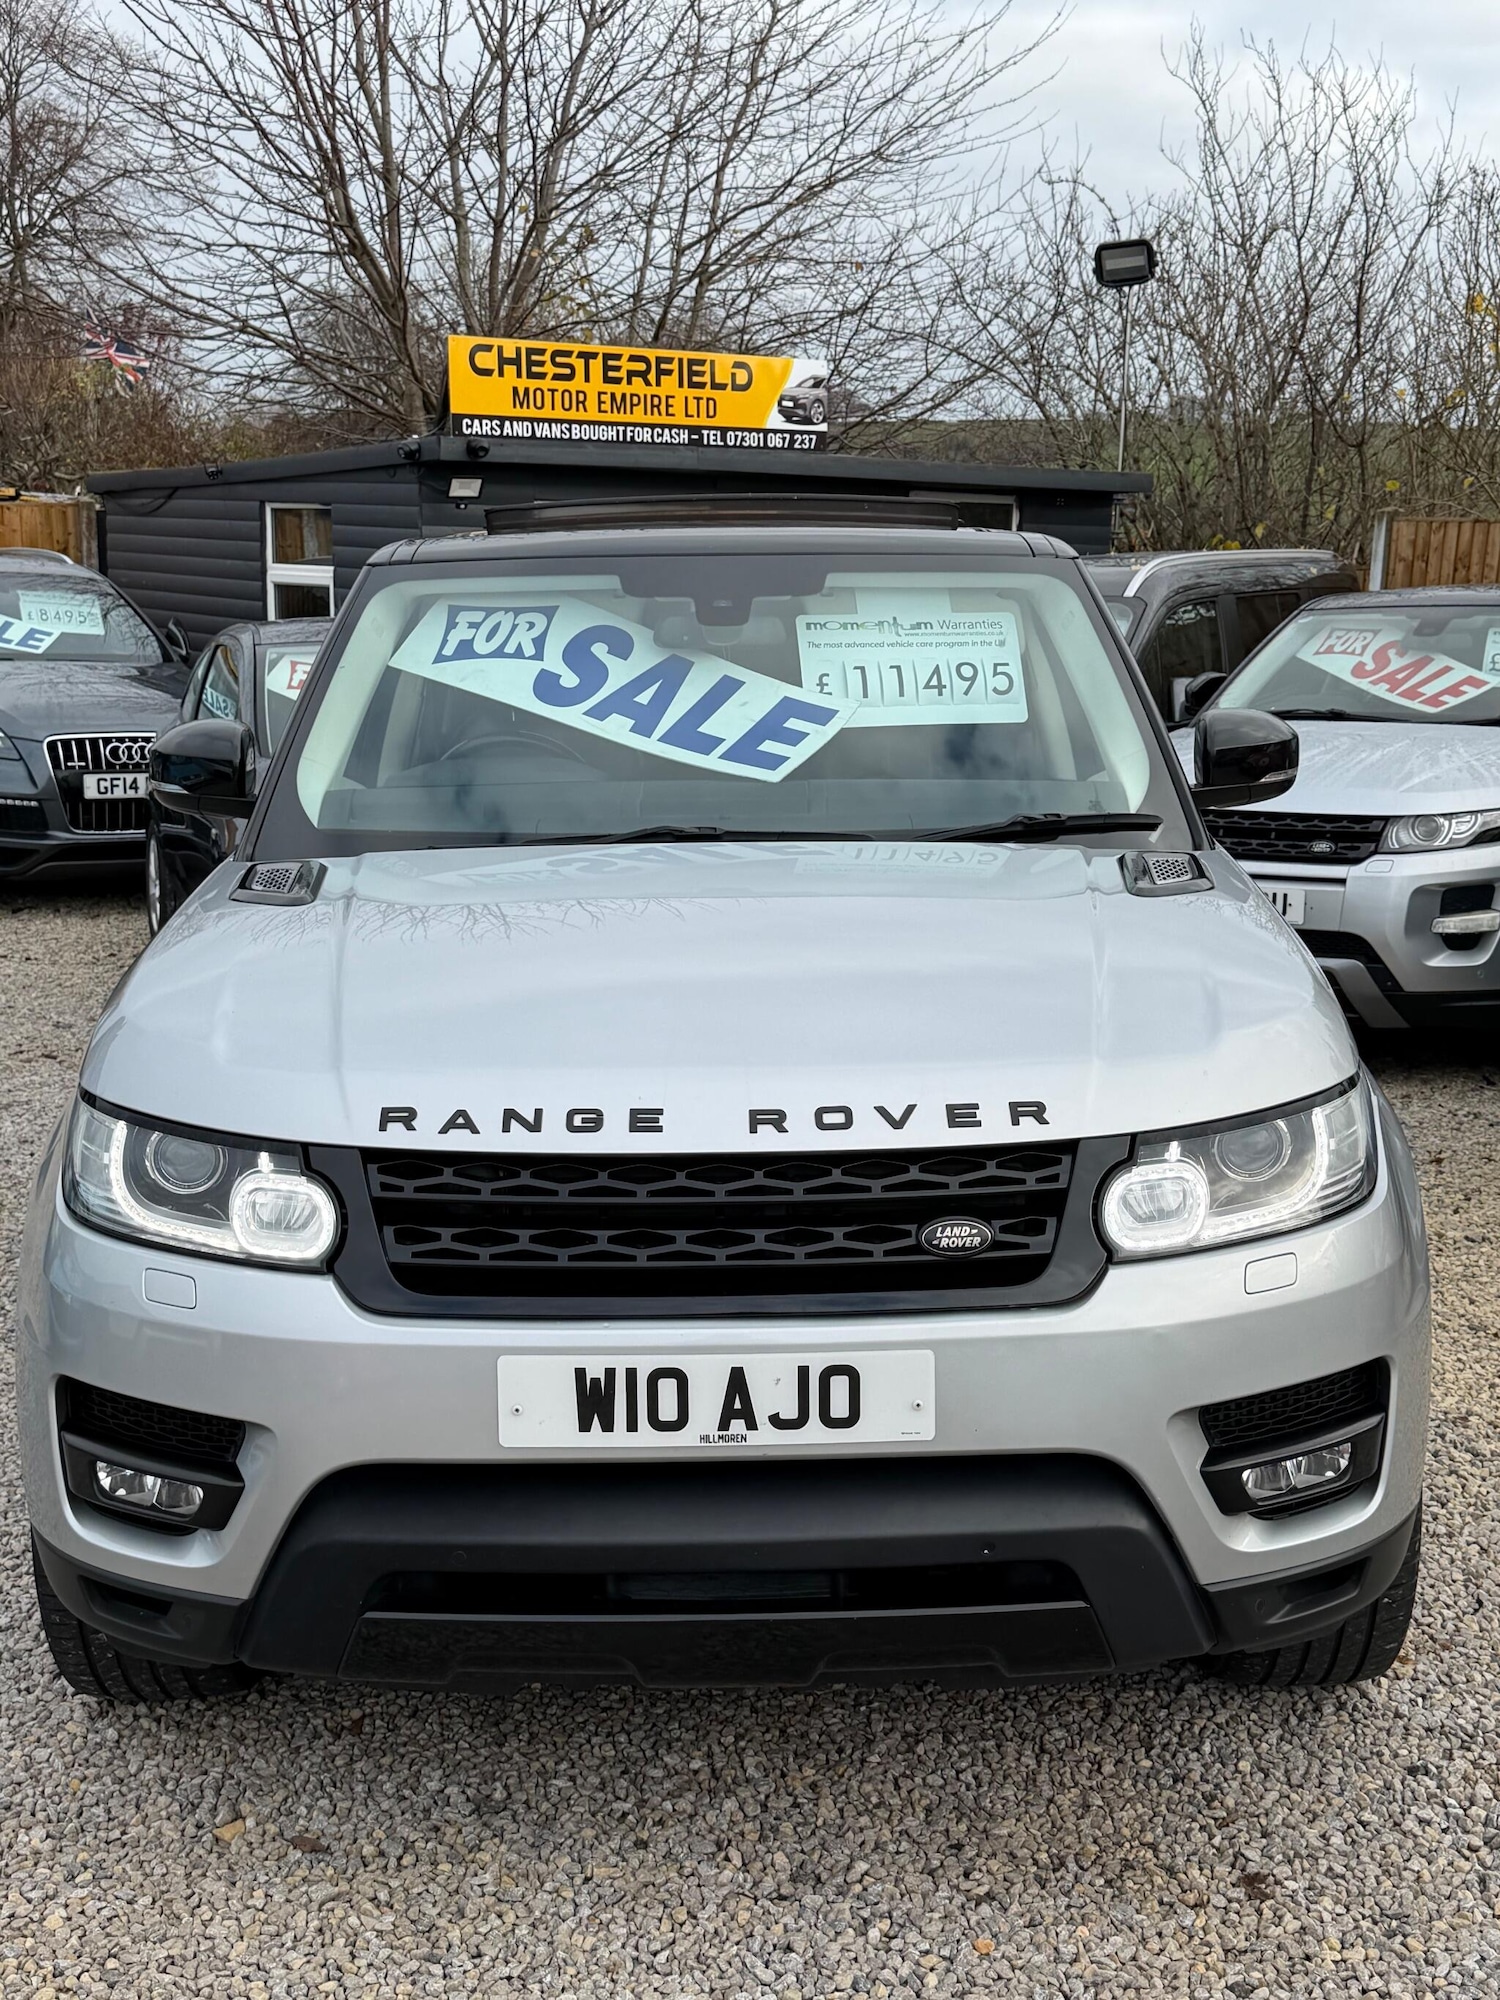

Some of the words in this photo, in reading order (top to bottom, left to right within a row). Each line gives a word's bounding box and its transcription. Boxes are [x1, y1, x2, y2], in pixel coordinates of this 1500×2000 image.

[469, 344, 753, 392] CHESTERFIELD
[512, 386, 588, 413] MOTOR
[598, 391, 676, 417] EMPIRE
[684, 396, 717, 419] LTD
[462, 418, 501, 436] CARS
[503, 420, 532, 437] AND
[533, 422, 570, 439] VANS
[571, 425, 626, 442] BOUGHT
[627, 426, 653, 442] FOR
[653, 427, 689, 444] CASH
[702, 429, 724, 446] TEL
[726, 431, 764, 447] 07301
[767, 432, 790, 448] 067
[793, 434, 817, 450] 237
[805, 616, 934, 638] momentum
[937, 618, 1003, 630] Warranties
[807, 640, 822, 649] The
[823, 641, 843, 649] most
[844, 640, 885, 649] advanced
[886, 640, 914, 649] vehicle
[935, 640, 970, 649] program
[971, 639, 979, 648] in
[980, 639, 993, 648] the
[1318, 629, 1375, 656] FOR
[1351, 639, 1490, 709] SALE
[442, 606, 549, 659] FOR
[532, 624, 840, 771] SALE
[97, 776, 140, 795] GF14
[378, 1106, 665, 1135] RANGE
[748, 1101, 1050, 1135] ROVER
[935, 1226, 971, 1238] LAND
[939, 1236, 982, 1249] ROVER
[574, 1366, 689, 1433] W10
[717, 1364, 861, 1432] AJO
[699, 1433, 748, 1444] HILLMOREN
